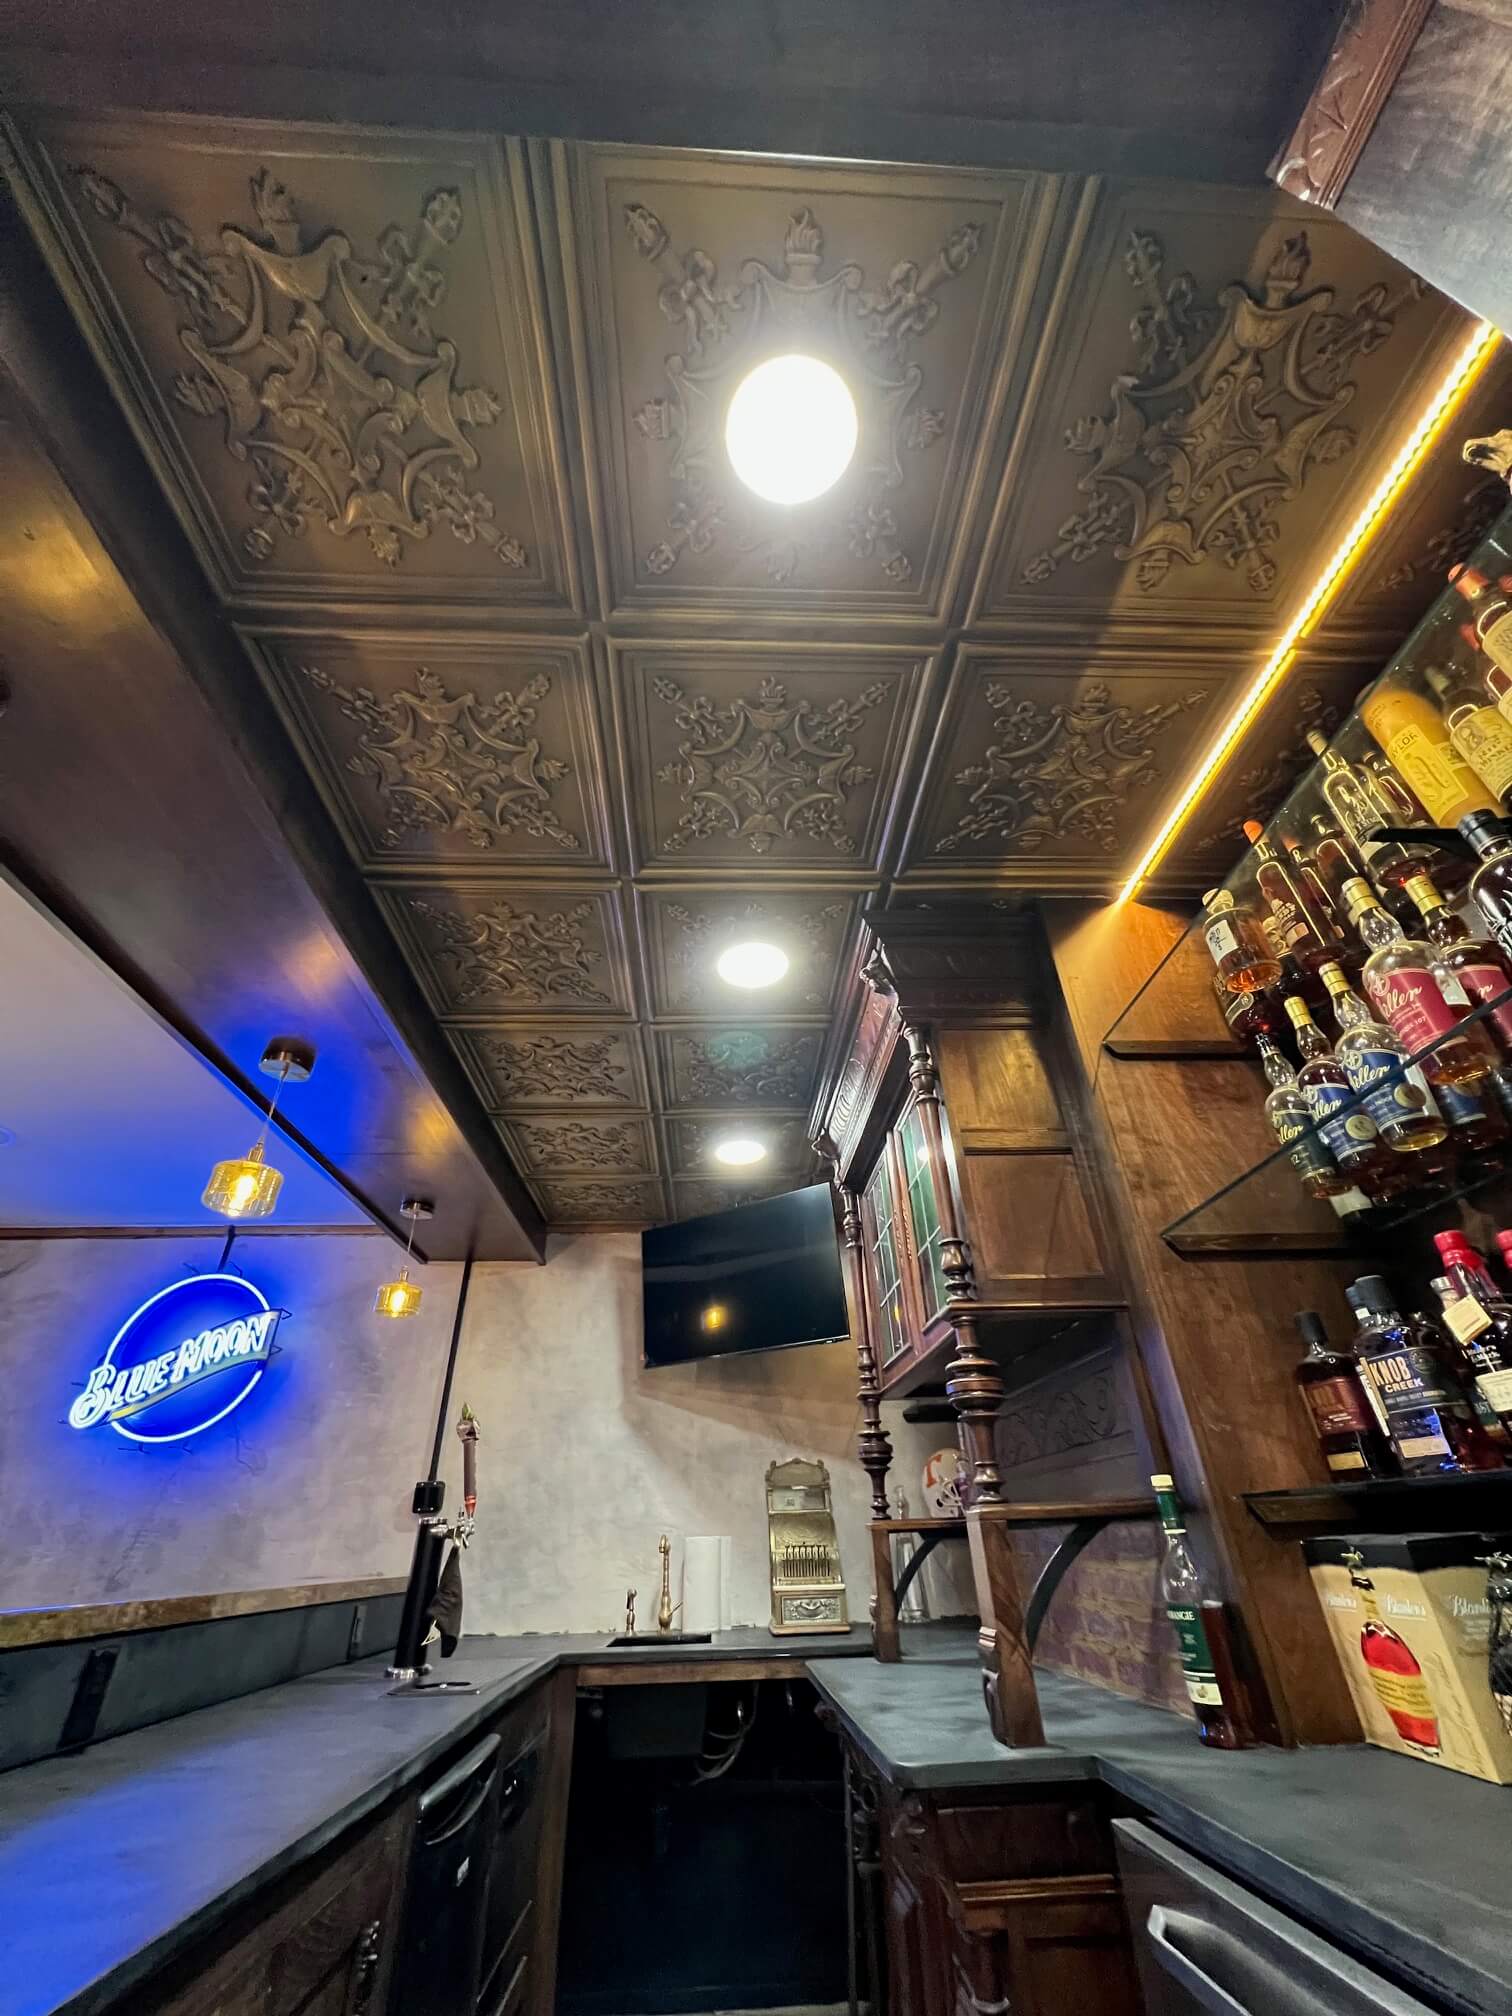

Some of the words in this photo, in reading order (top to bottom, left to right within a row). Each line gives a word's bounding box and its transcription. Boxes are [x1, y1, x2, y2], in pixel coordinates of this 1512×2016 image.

[69, 1350, 177, 1429] BLUE
[170, 1315, 276, 1383] MOON
[1369, 1356, 1412, 1386] KNOB
[1385, 1378, 1425, 1393] CREEK
